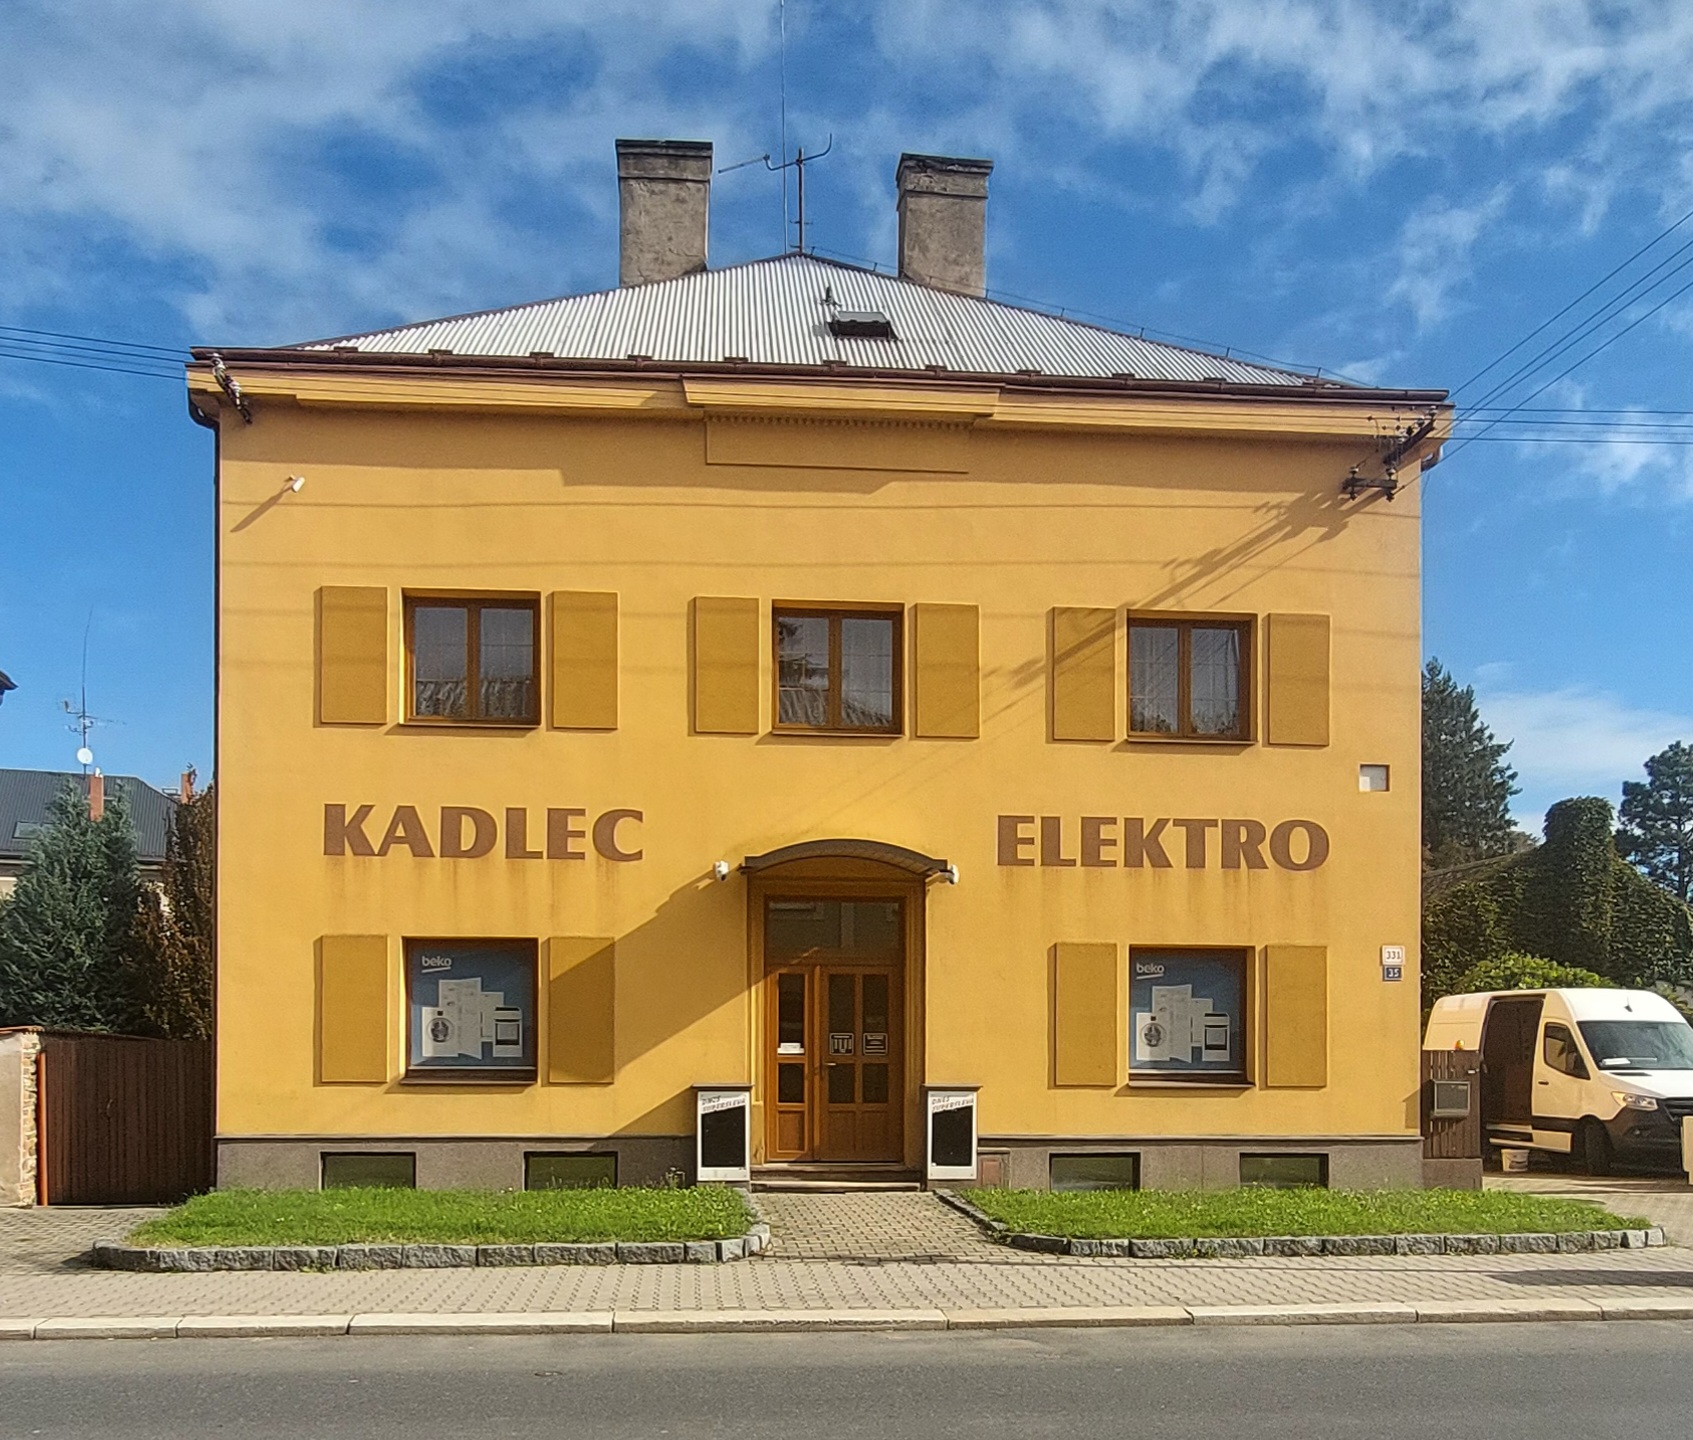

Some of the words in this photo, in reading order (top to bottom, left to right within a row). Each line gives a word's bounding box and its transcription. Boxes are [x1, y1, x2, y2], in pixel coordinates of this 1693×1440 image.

[323, 803, 643, 862] KADLEC
[997, 815, 1330, 871] ELEKTRO
[421, 955, 452, 967] beko
[1386, 950, 1401, 960] 331
[1136, 962, 1165, 974] beko
